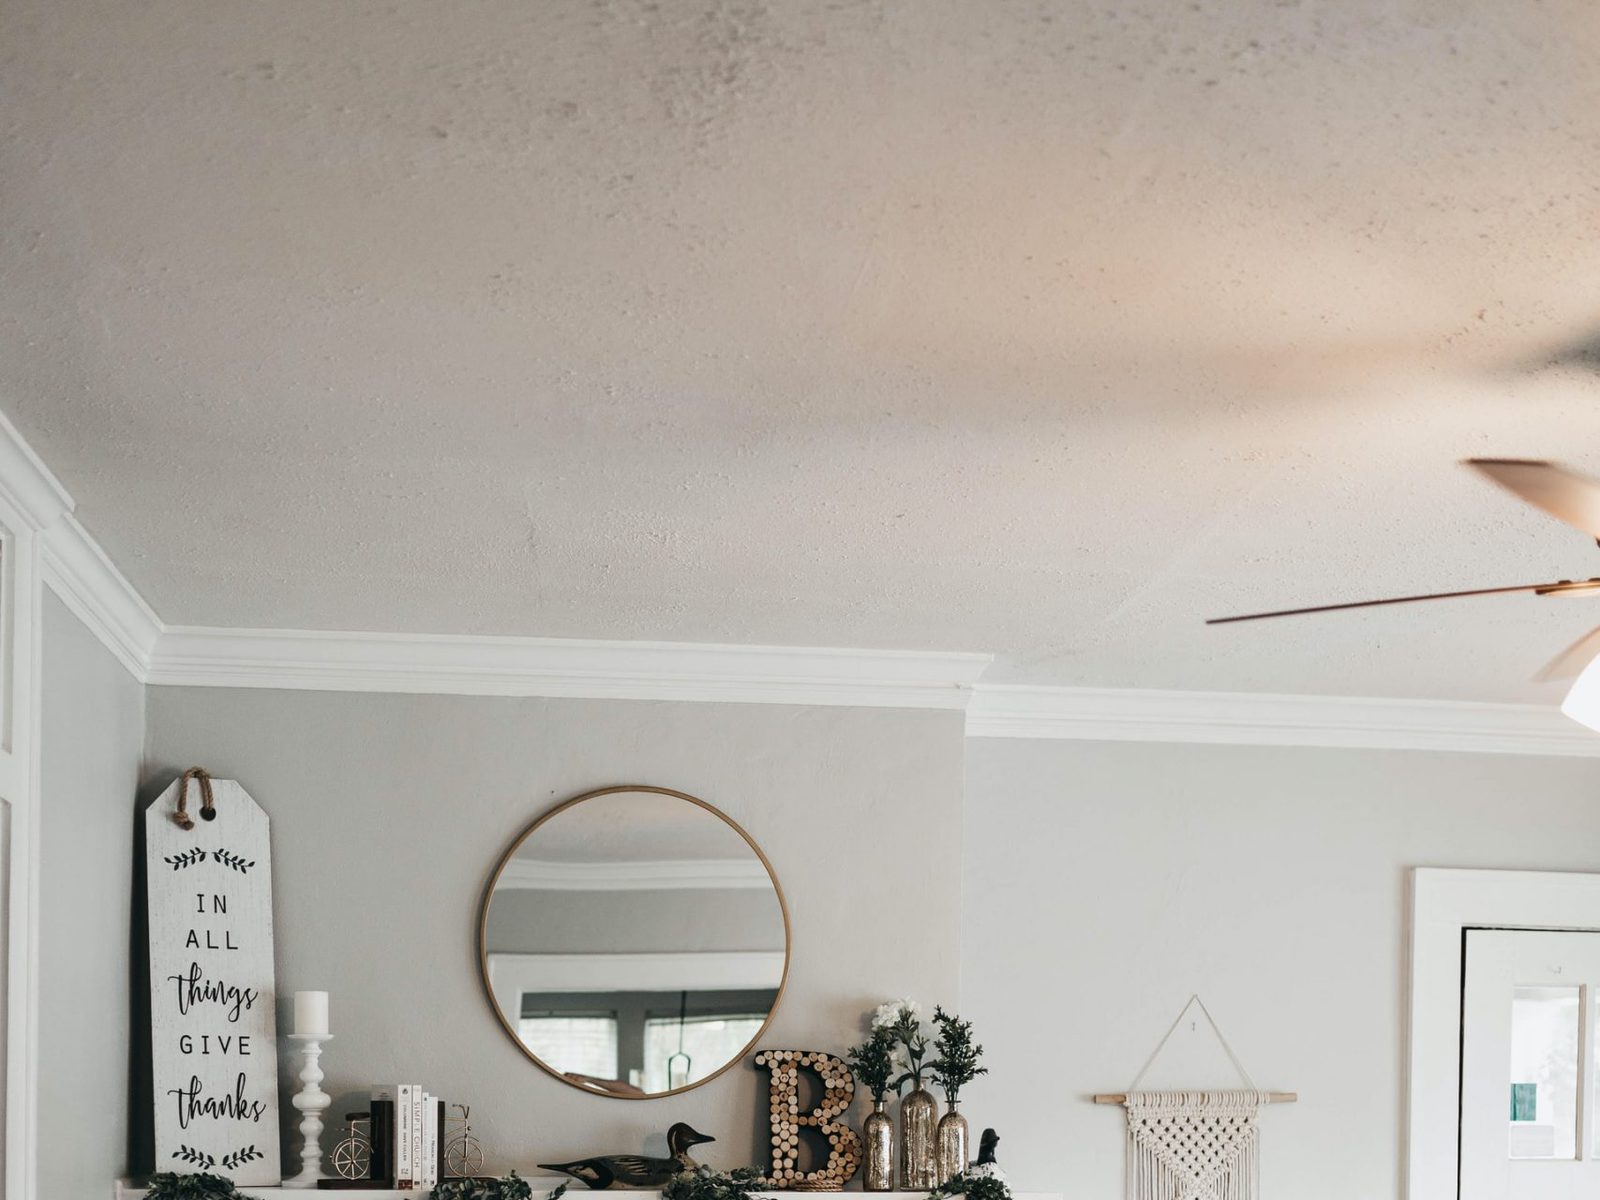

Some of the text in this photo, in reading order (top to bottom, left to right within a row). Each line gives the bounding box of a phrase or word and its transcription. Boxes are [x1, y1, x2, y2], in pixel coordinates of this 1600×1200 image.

[196, 893, 227, 914] IN
[185, 929, 239, 950] ALL
[167, 961, 259, 1023] things
[179, 1034, 251, 1056] GIVE
[167, 1072, 267, 1130] thanks
[754, 1050, 863, 1188] B
